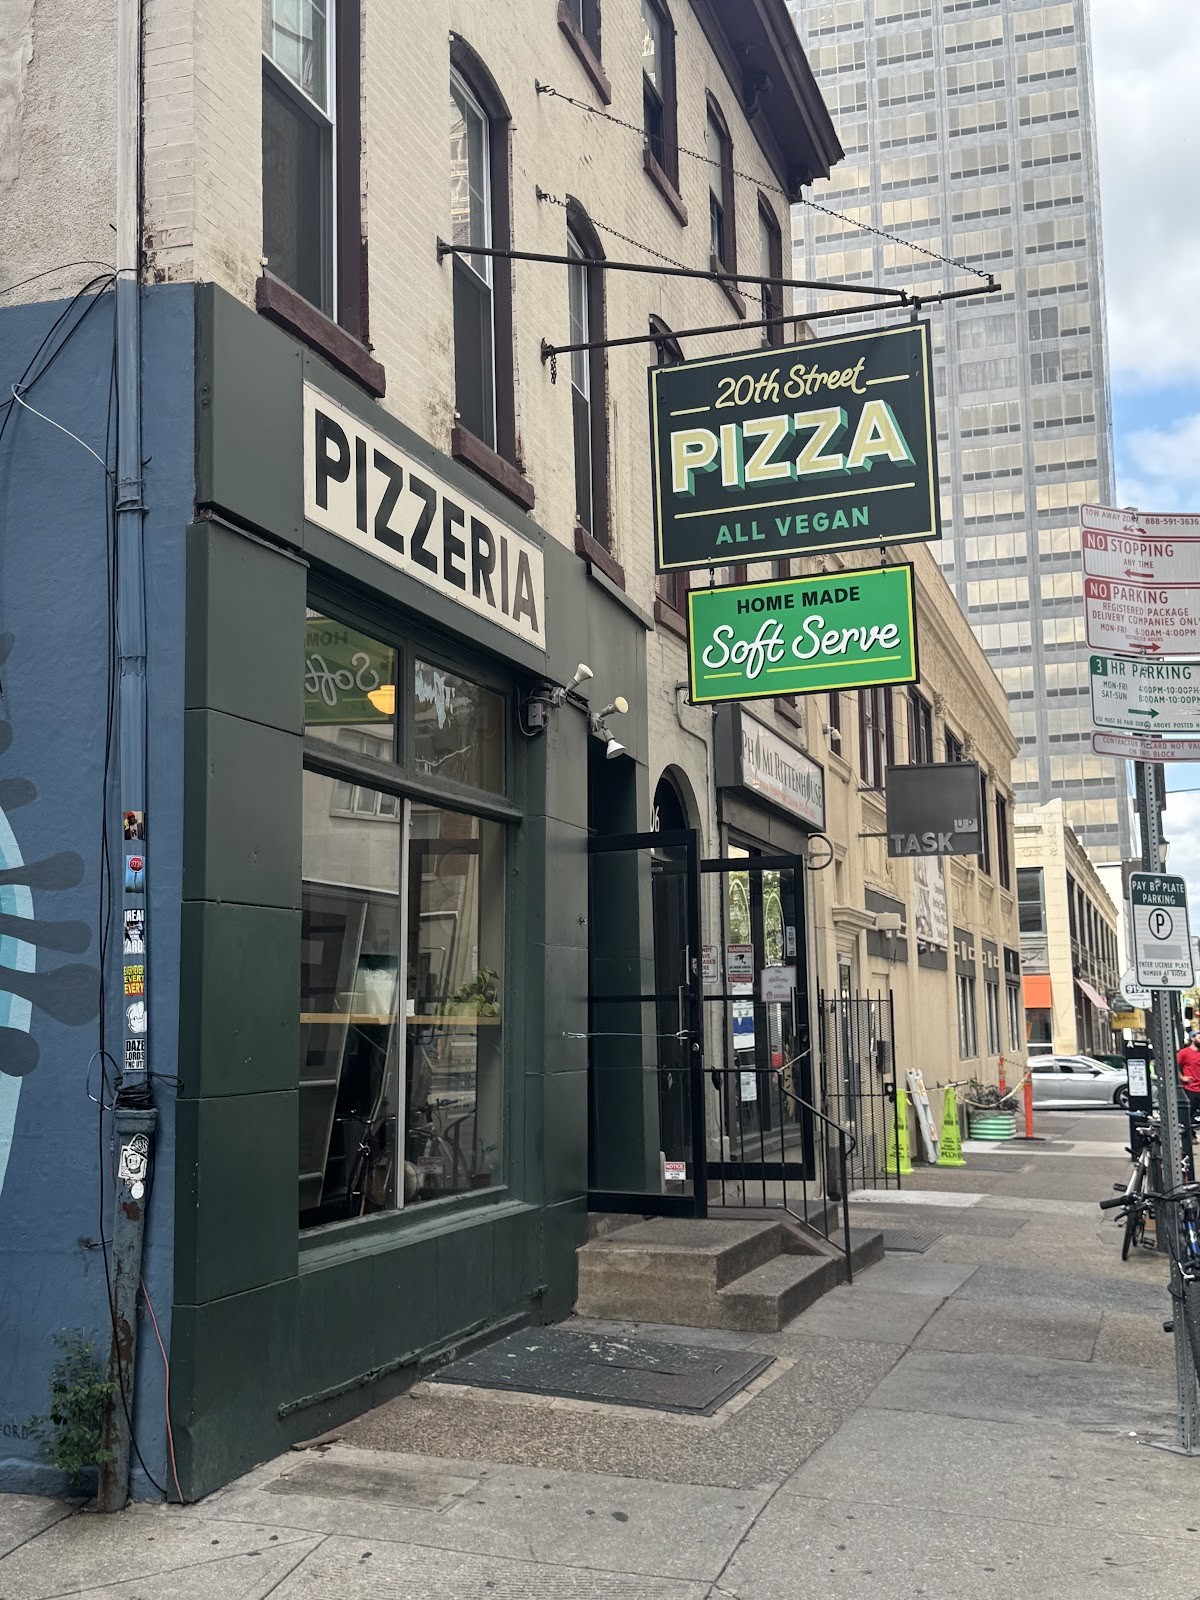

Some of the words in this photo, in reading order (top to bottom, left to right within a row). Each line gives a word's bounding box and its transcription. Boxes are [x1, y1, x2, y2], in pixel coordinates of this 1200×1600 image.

[715, 367, 780, 409] 20th
[783, 356, 866, 399] Street
[670, 399, 916, 498] PIZZA
[315, 408, 539, 634] PIZZERIA
[1085, 508, 1099, 517] TOW
[1102, 510, 1120, 520] AWAY
[1122, 515, 1139, 523] ZO
[1145, 517, 1200, 525] 888-591-3636
[715, 520, 766, 545] ALL
[775, 506, 869, 535] VEGAN
[1087, 533, 1105, 549] NO
[1111, 538, 1174, 557] STOPPING
[1123, 558, 1136, 567] ANY
[1138, 560, 1154, 569] TIME
[737, 593, 794, 614] HOME
[802, 586, 860, 607] MADE
[1090, 582, 1107, 598] NO
[1113, 586, 1169, 604] PARKING
[1092, 610, 1125, 622] DELIVERY
[1128, 615, 1175, 626] COMPANIES
[1103, 602, 1144, 616] REGISTERED
[1147, 608, 1189, 617] PACKAGE
[1100, 623, 1127, 634] MON-FRI
[702, 618, 785, 679] Soft
[791, 614, 901, 659] Serve
[1096, 660, 1103, 673] 3
[1111, 661, 1126, 676] HR
[1132, 664, 1192, 680] PARKING
[1103, 681, 1128, 690] MON-FRI
[1102, 690, 1128, 700] SAT-SUN
[956, 819, 974, 829] UP
[890, 831, 954, 854] TASK
[1132, 880, 1147, 891] PAY
[1162, 882, 1185, 894] PLATE
[1142, 893, 1176, 905] PARKING
[1139, 960, 1153, 968] ENTER
